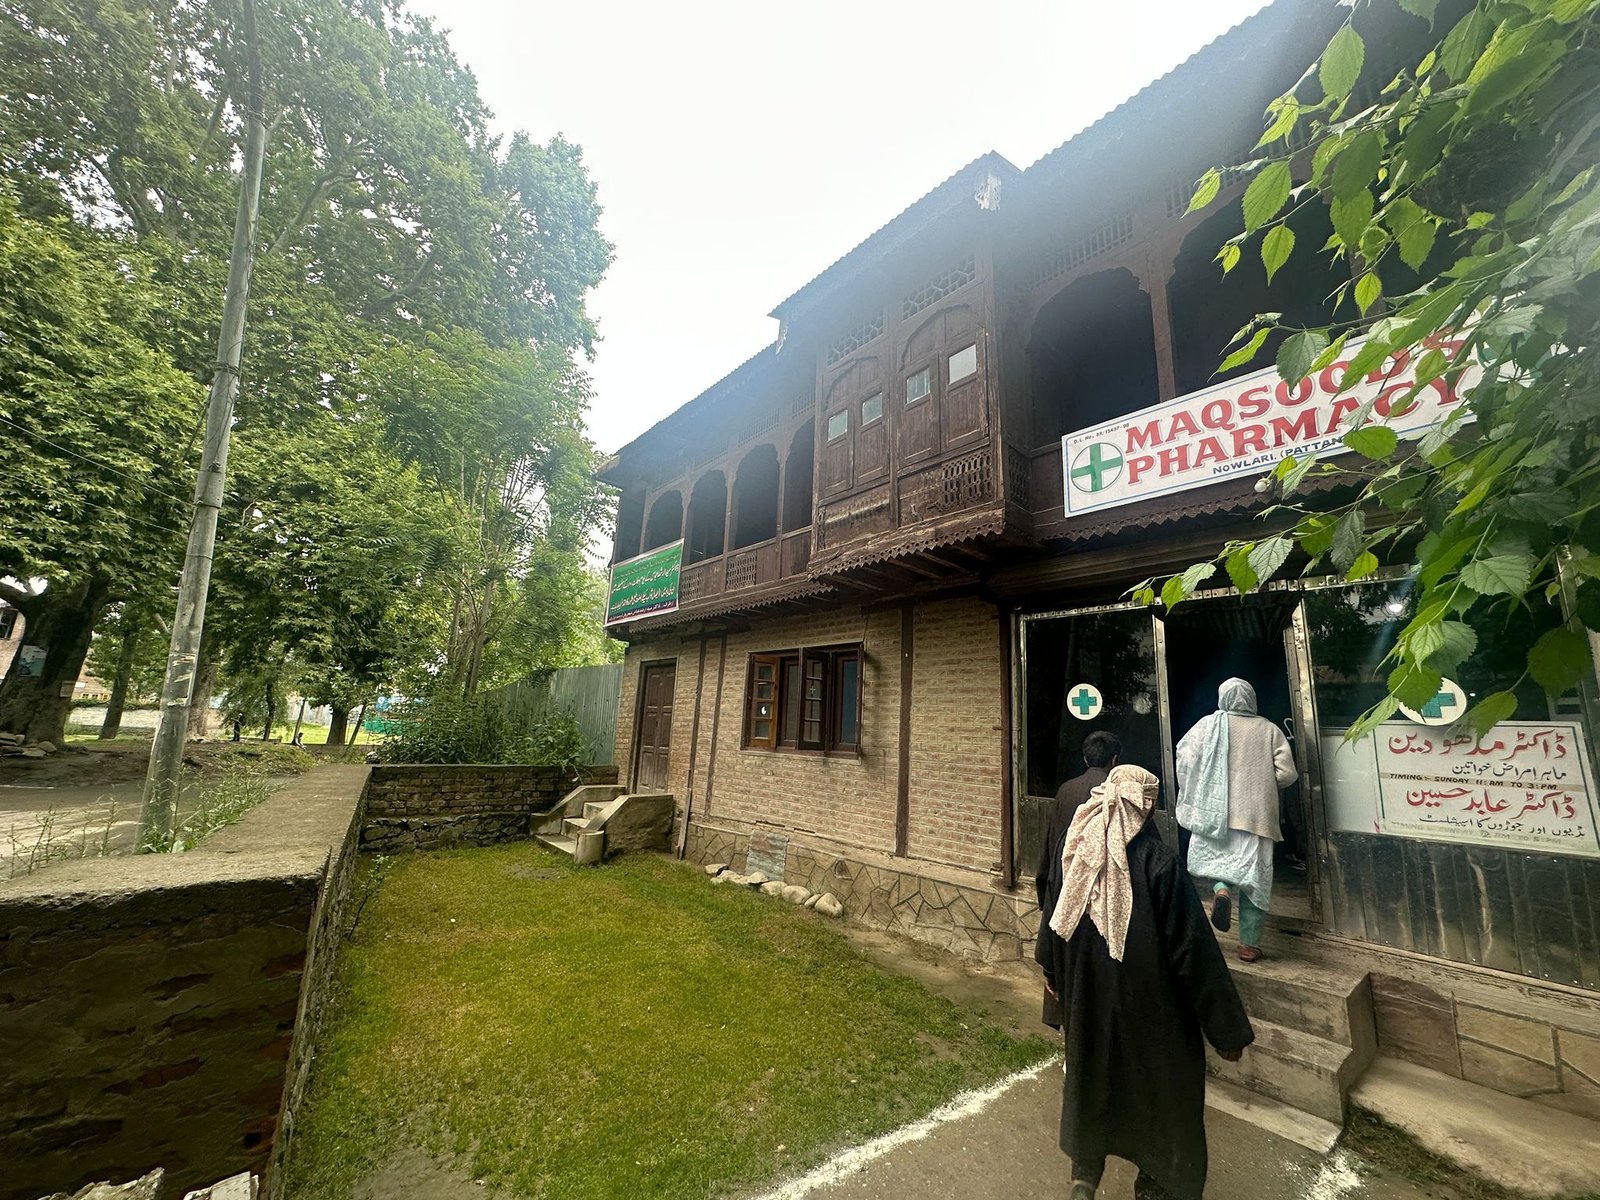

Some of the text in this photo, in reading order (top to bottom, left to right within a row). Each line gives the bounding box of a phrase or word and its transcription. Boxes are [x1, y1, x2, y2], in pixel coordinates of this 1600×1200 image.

[1127, 362, 1474, 485] PHARMACY
[1499, 729, 1567, 761] ڈاکٹر
[1452, 761, 1492, 776] خواتین
[1540, 766, 1567, 781] ماہر
[1434, 776, 1470, 785] SUNDAY
[1511, 781, 1523, 789] TO
[1406, 787, 1576, 819] ڈاکٹر عابد حسین
[1476, 816, 1492, 828] کا
[1487, 819, 1524, 833] جوڑوں
[1529, 826, 1547, 836] اور
